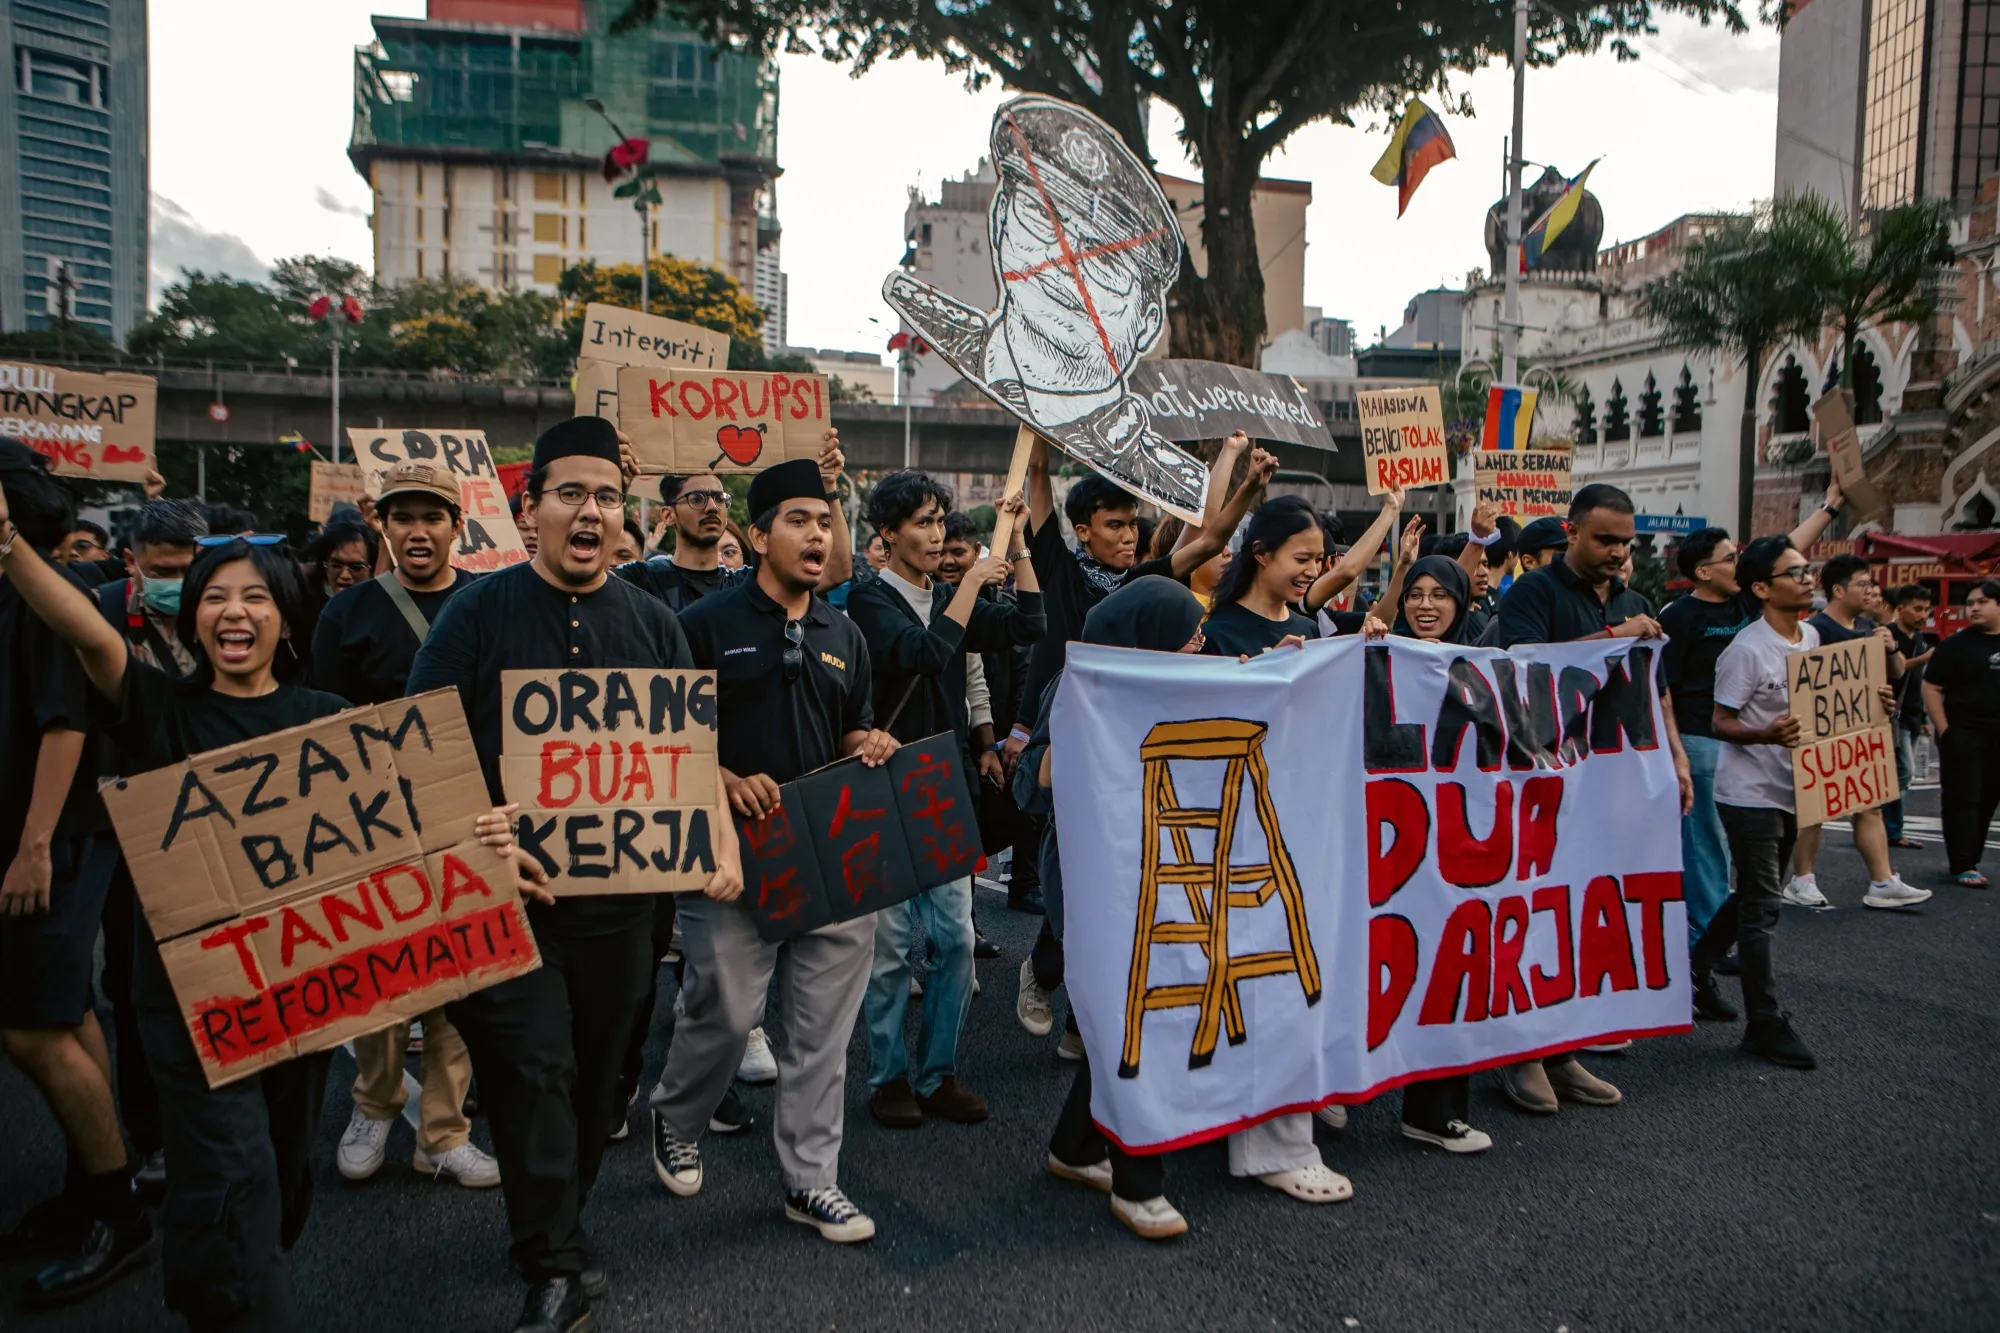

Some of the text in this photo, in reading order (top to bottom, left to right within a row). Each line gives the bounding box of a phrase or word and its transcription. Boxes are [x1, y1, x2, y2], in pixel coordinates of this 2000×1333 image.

[0, 390, 137, 424] TANGKAP
[649, 373, 822, 422] KORUPSI
[1361, 396, 1428, 418] MAHASISWA
[1401, 424, 1442, 448] TOLAK
[1475, 453, 1570, 472] LAHIR SEBAGAI
[1378, 457, 1442, 489] RASUAH
[1480, 487, 1517, 502] MATI
[1496, 472, 1557, 489] MANUSIA
[1647, 516, 1691, 530] JALAN RAJA
[821, 652, 846, 671] MUDA
[1795, 645, 1867, 693] AZAM
[512, 671, 717, 736] ORANG
[1363, 645, 1658, 772] LAWAN
[1814, 684, 1871, 737] BAKI
[161, 705, 433, 852] AZAM
[538, 740, 691, 809] BUAT
[1801, 732, 1886, 790] SUDAH
[1824, 763, 1889, 817] BASI!
[241, 775, 421, 889] BAKI
[516, 809, 717, 878] KERJA
[1365, 776, 1563, 908] DUA
[201, 853, 492, 989] TANDA
[201, 904, 518, 1060] REFORMATI!
[1365, 872, 1683, 1053] DARJAT
